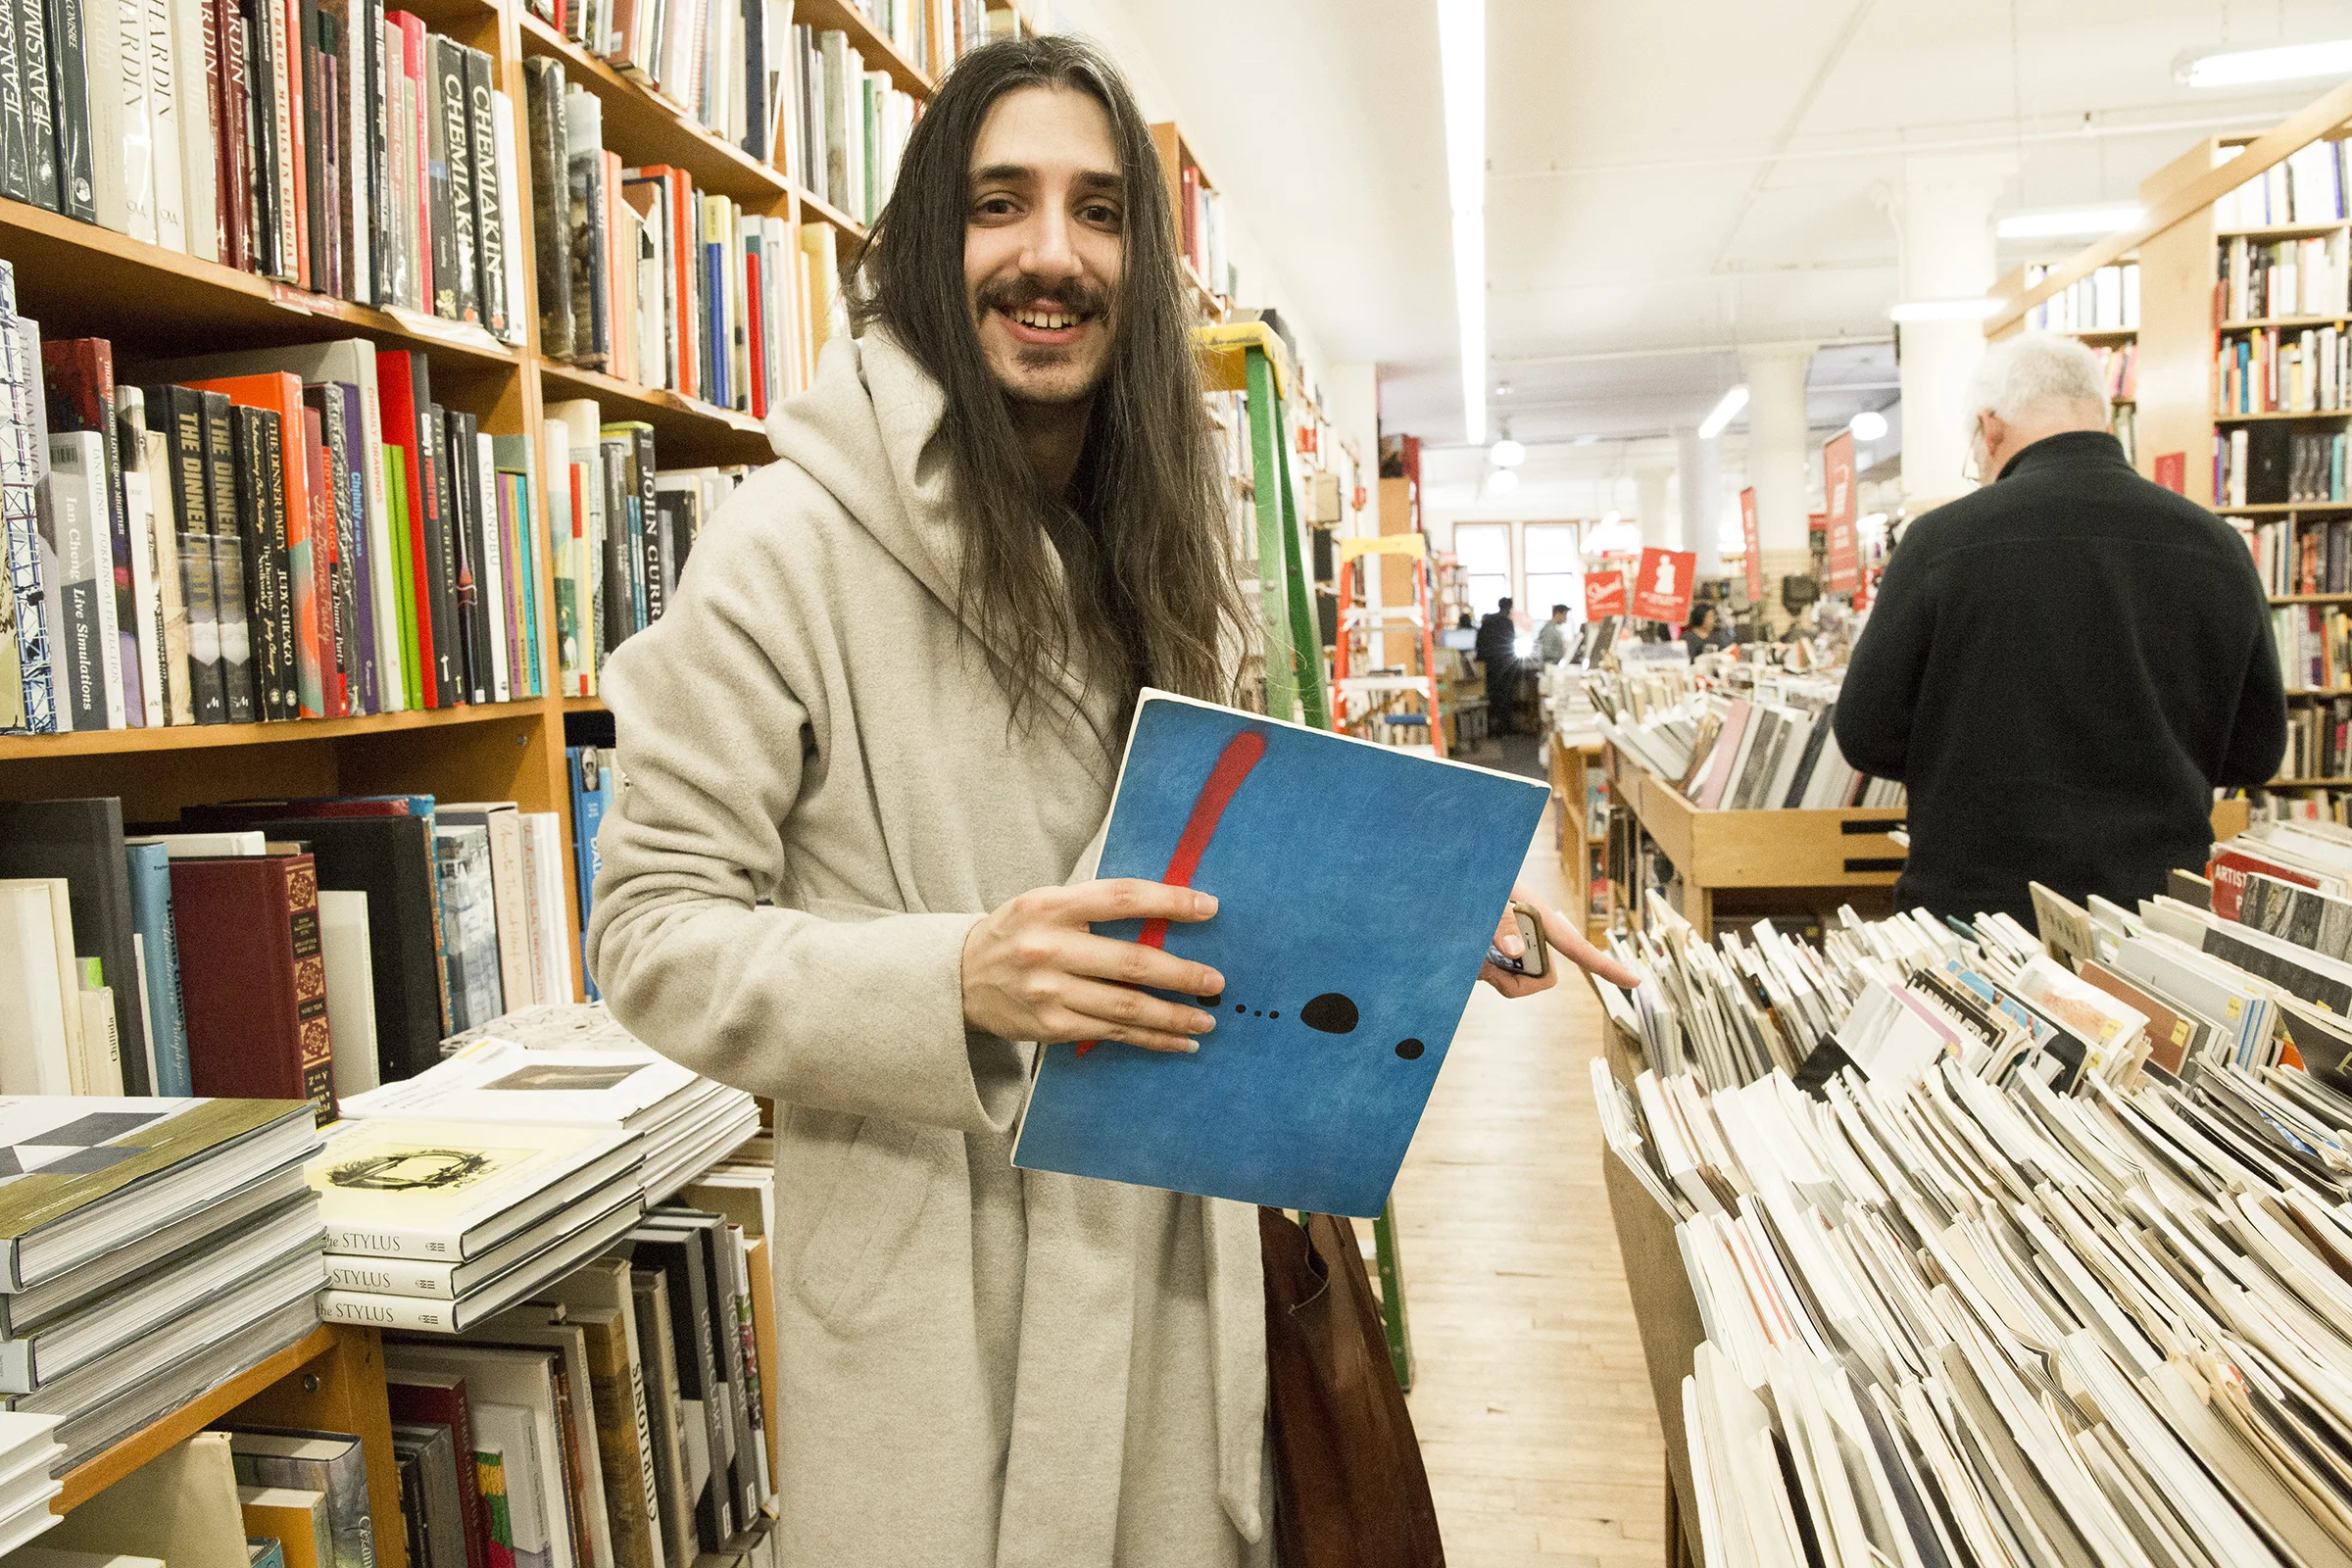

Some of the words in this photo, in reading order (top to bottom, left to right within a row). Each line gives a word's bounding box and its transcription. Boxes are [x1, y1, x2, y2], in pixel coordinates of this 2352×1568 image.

[274, 6, 285, 80] CHARLOT
[283, 187, 294, 258] GEORGIA
[472, 85, 504, 278] CHEMIAKIN
[179, 412, 201, 453] THE
[210, 417, 231, 456] THE
[269, 419, 279, 452] THE
[368, 386, 379, 436] CHIHULY
[93, 448, 102, 469] IAN
[104, 360, 114, 390] THOSE
[114, 491, 125, 536] MIGHTIER
[323, 454, 332, 485] JUDY
[371, 441, 383, 503] DRAWINGS
[95, 473, 106, 515] CHENG
[182, 456, 208, 536] DINNER
[214, 460, 239, 536] DINNER
[271, 453, 282, 508] DINNER
[351, 471, 364, 519] Chihuly
[439, 476, 449, 516] DALE
[641, 466, 659, 537] JOHN
[66, 496, 78, 521] Ian
[274, 509, 286, 553] PARTY
[314, 494, 327, 527] The
[326, 489, 336, 550] CHICAGO
[483, 462, 500, 566] CHIKANOBU
[69, 525, 82, 579] Cheng
[189, 540, 212, 612] PARTY
[220, 543, 242, 611] PARTY
[317, 529, 329, 594] Dinner
[443, 524, 454, 595] CHIHULY
[73, 586, 86, 617] Live
[277, 568, 289, 603] JUDY
[331, 573, 340, 594] The
[647, 545, 663, 624] CURR
[280, 604, 293, 665] CHICAGO
[318, 598, 332, 645] Party
[332, 595, 343, 633] Dinner
[75, 620, 94, 710] Simulations
[335, 636, 345, 665] Party
[166, 896, 178, 965] Thomas
[173, 968, 186, 1032] Chimes
[107, 1016, 119, 1062] Chillida
[308, 1076, 315, 1086] Z
[321, 1071, 328, 1080] A
[324, 1233, 339, 1248] he
[342, 1232, 401, 1252] STYLUS
[332, 1268, 391, 1289] STYLUS
[335, 1302, 394, 1323] STYLUS
[701, 1307, 715, 1369] LYGIA
[726, 1291, 742, 1351] LYGIA
[707, 1369, 723, 1437] CLARK
[732, 1351, 748, 1417] CLARK
[458, 1396, 470, 1452] PETRUS
[466, 1454, 477, 1528] CHRISTUS
